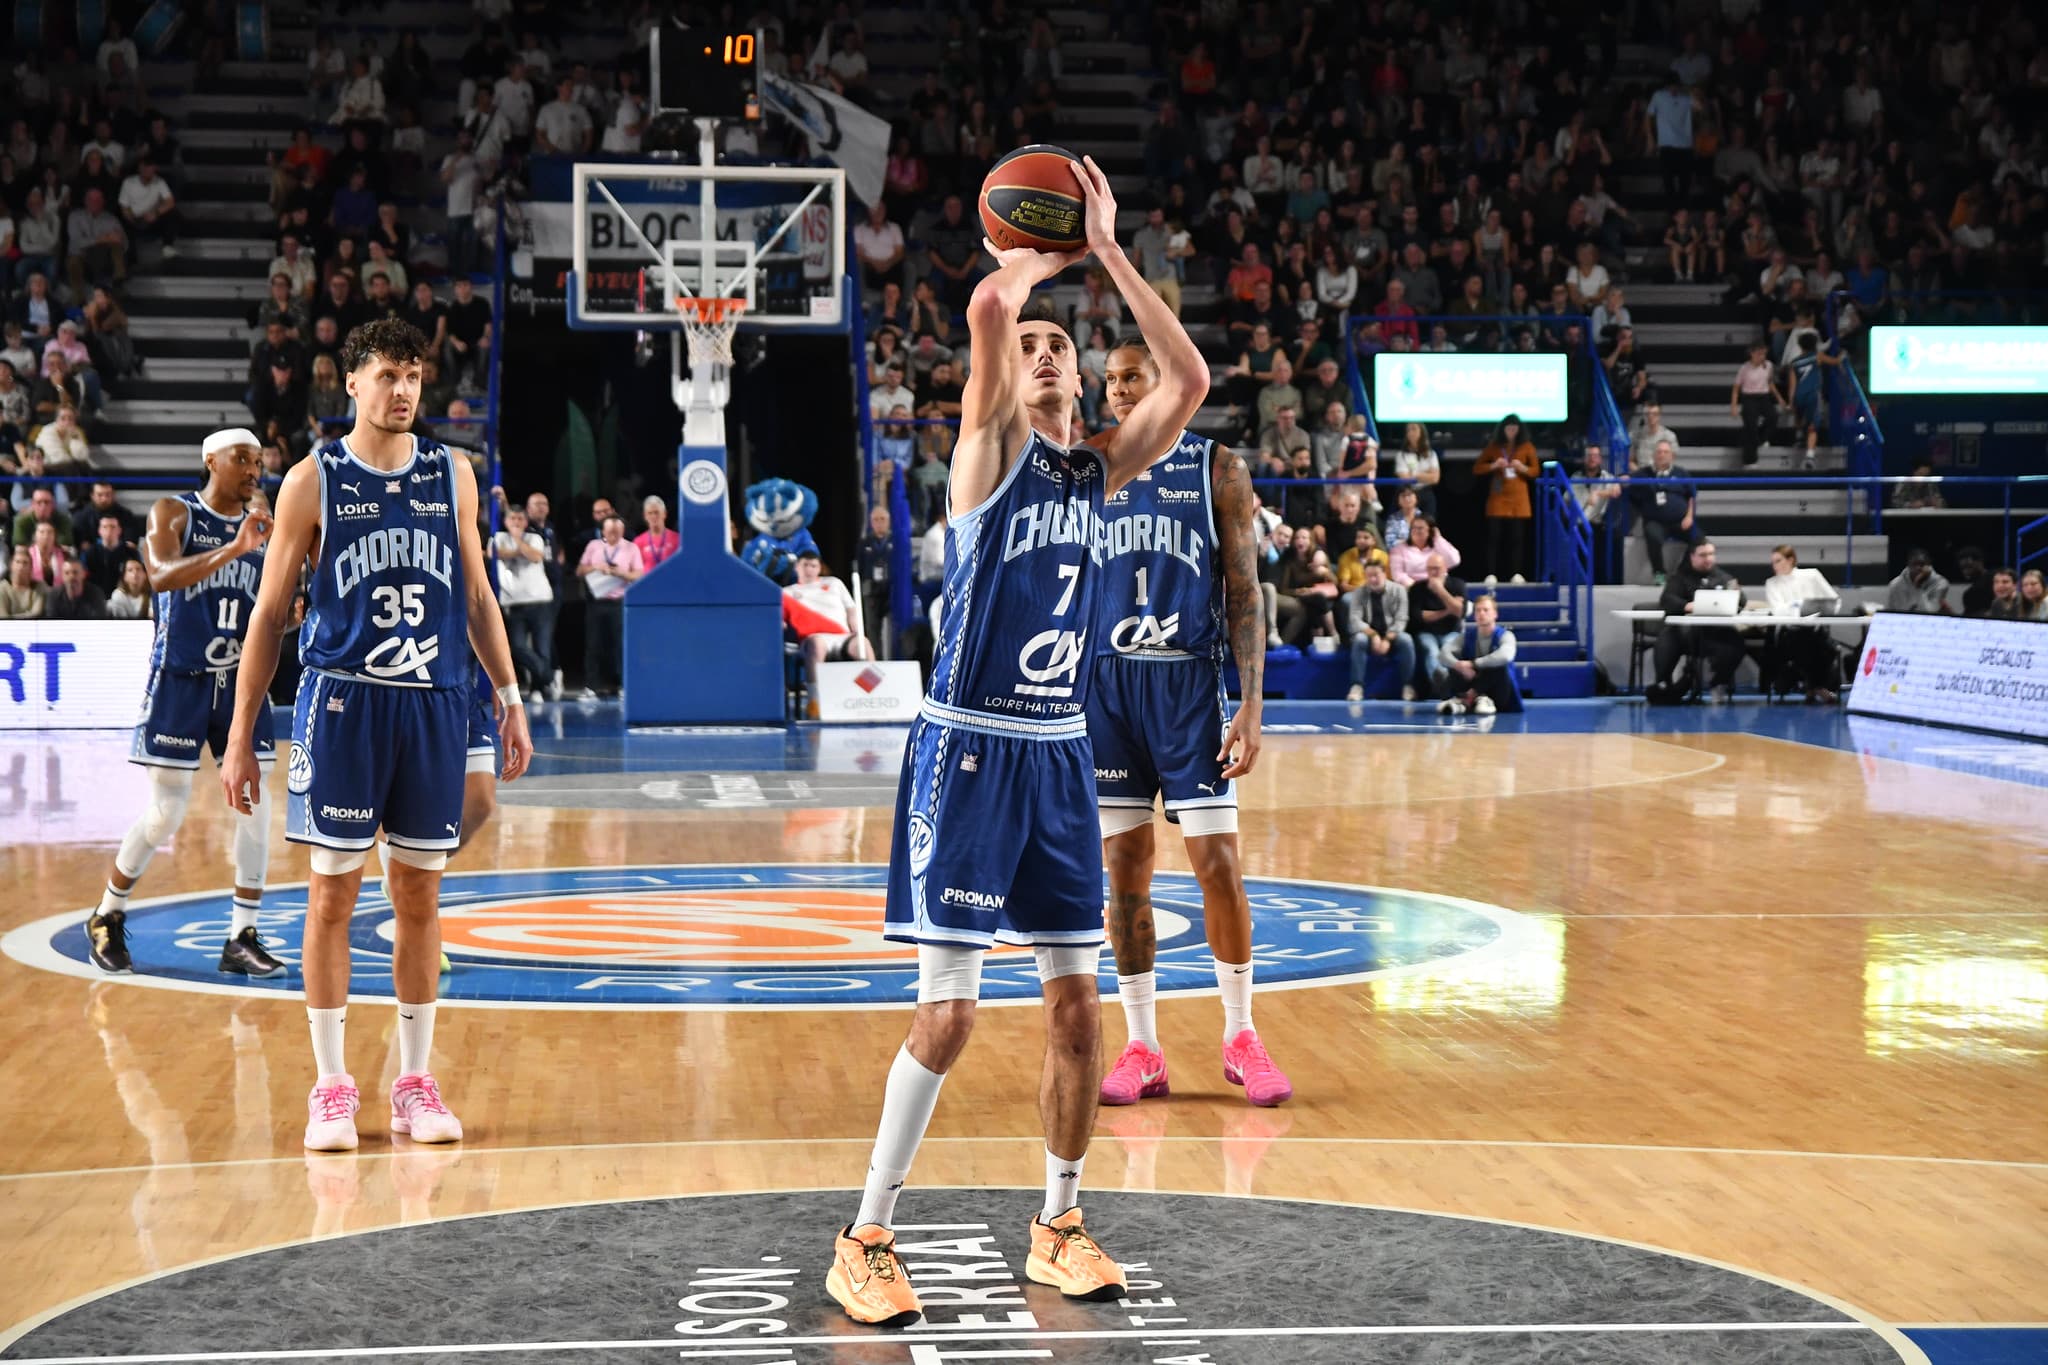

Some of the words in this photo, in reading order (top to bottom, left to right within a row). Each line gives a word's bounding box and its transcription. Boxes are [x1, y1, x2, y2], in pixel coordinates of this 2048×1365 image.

[724, 34, 754, 64] 10
[1032, 452, 1063, 483] Loe
[1158, 486, 1200, 499] Roanne
[336, 502, 380, 516] Loire
[1104, 514, 1204, 577] HORALE
[335, 528, 453, 599] CHORALE
[1052, 564, 1081, 616] 7
[1135, 566, 1149, 606] 1
[217, 597, 239, 630] 11
[371, 584, 426, 629] 35
[984, 696, 1024, 710] LOIRE
[154, 733, 197, 747] PROMAN
[1093, 768, 1128, 779] OMAN
[943, 887, 1006, 909] PROMAN
[674, 1256, 801, 1365] ISON.
